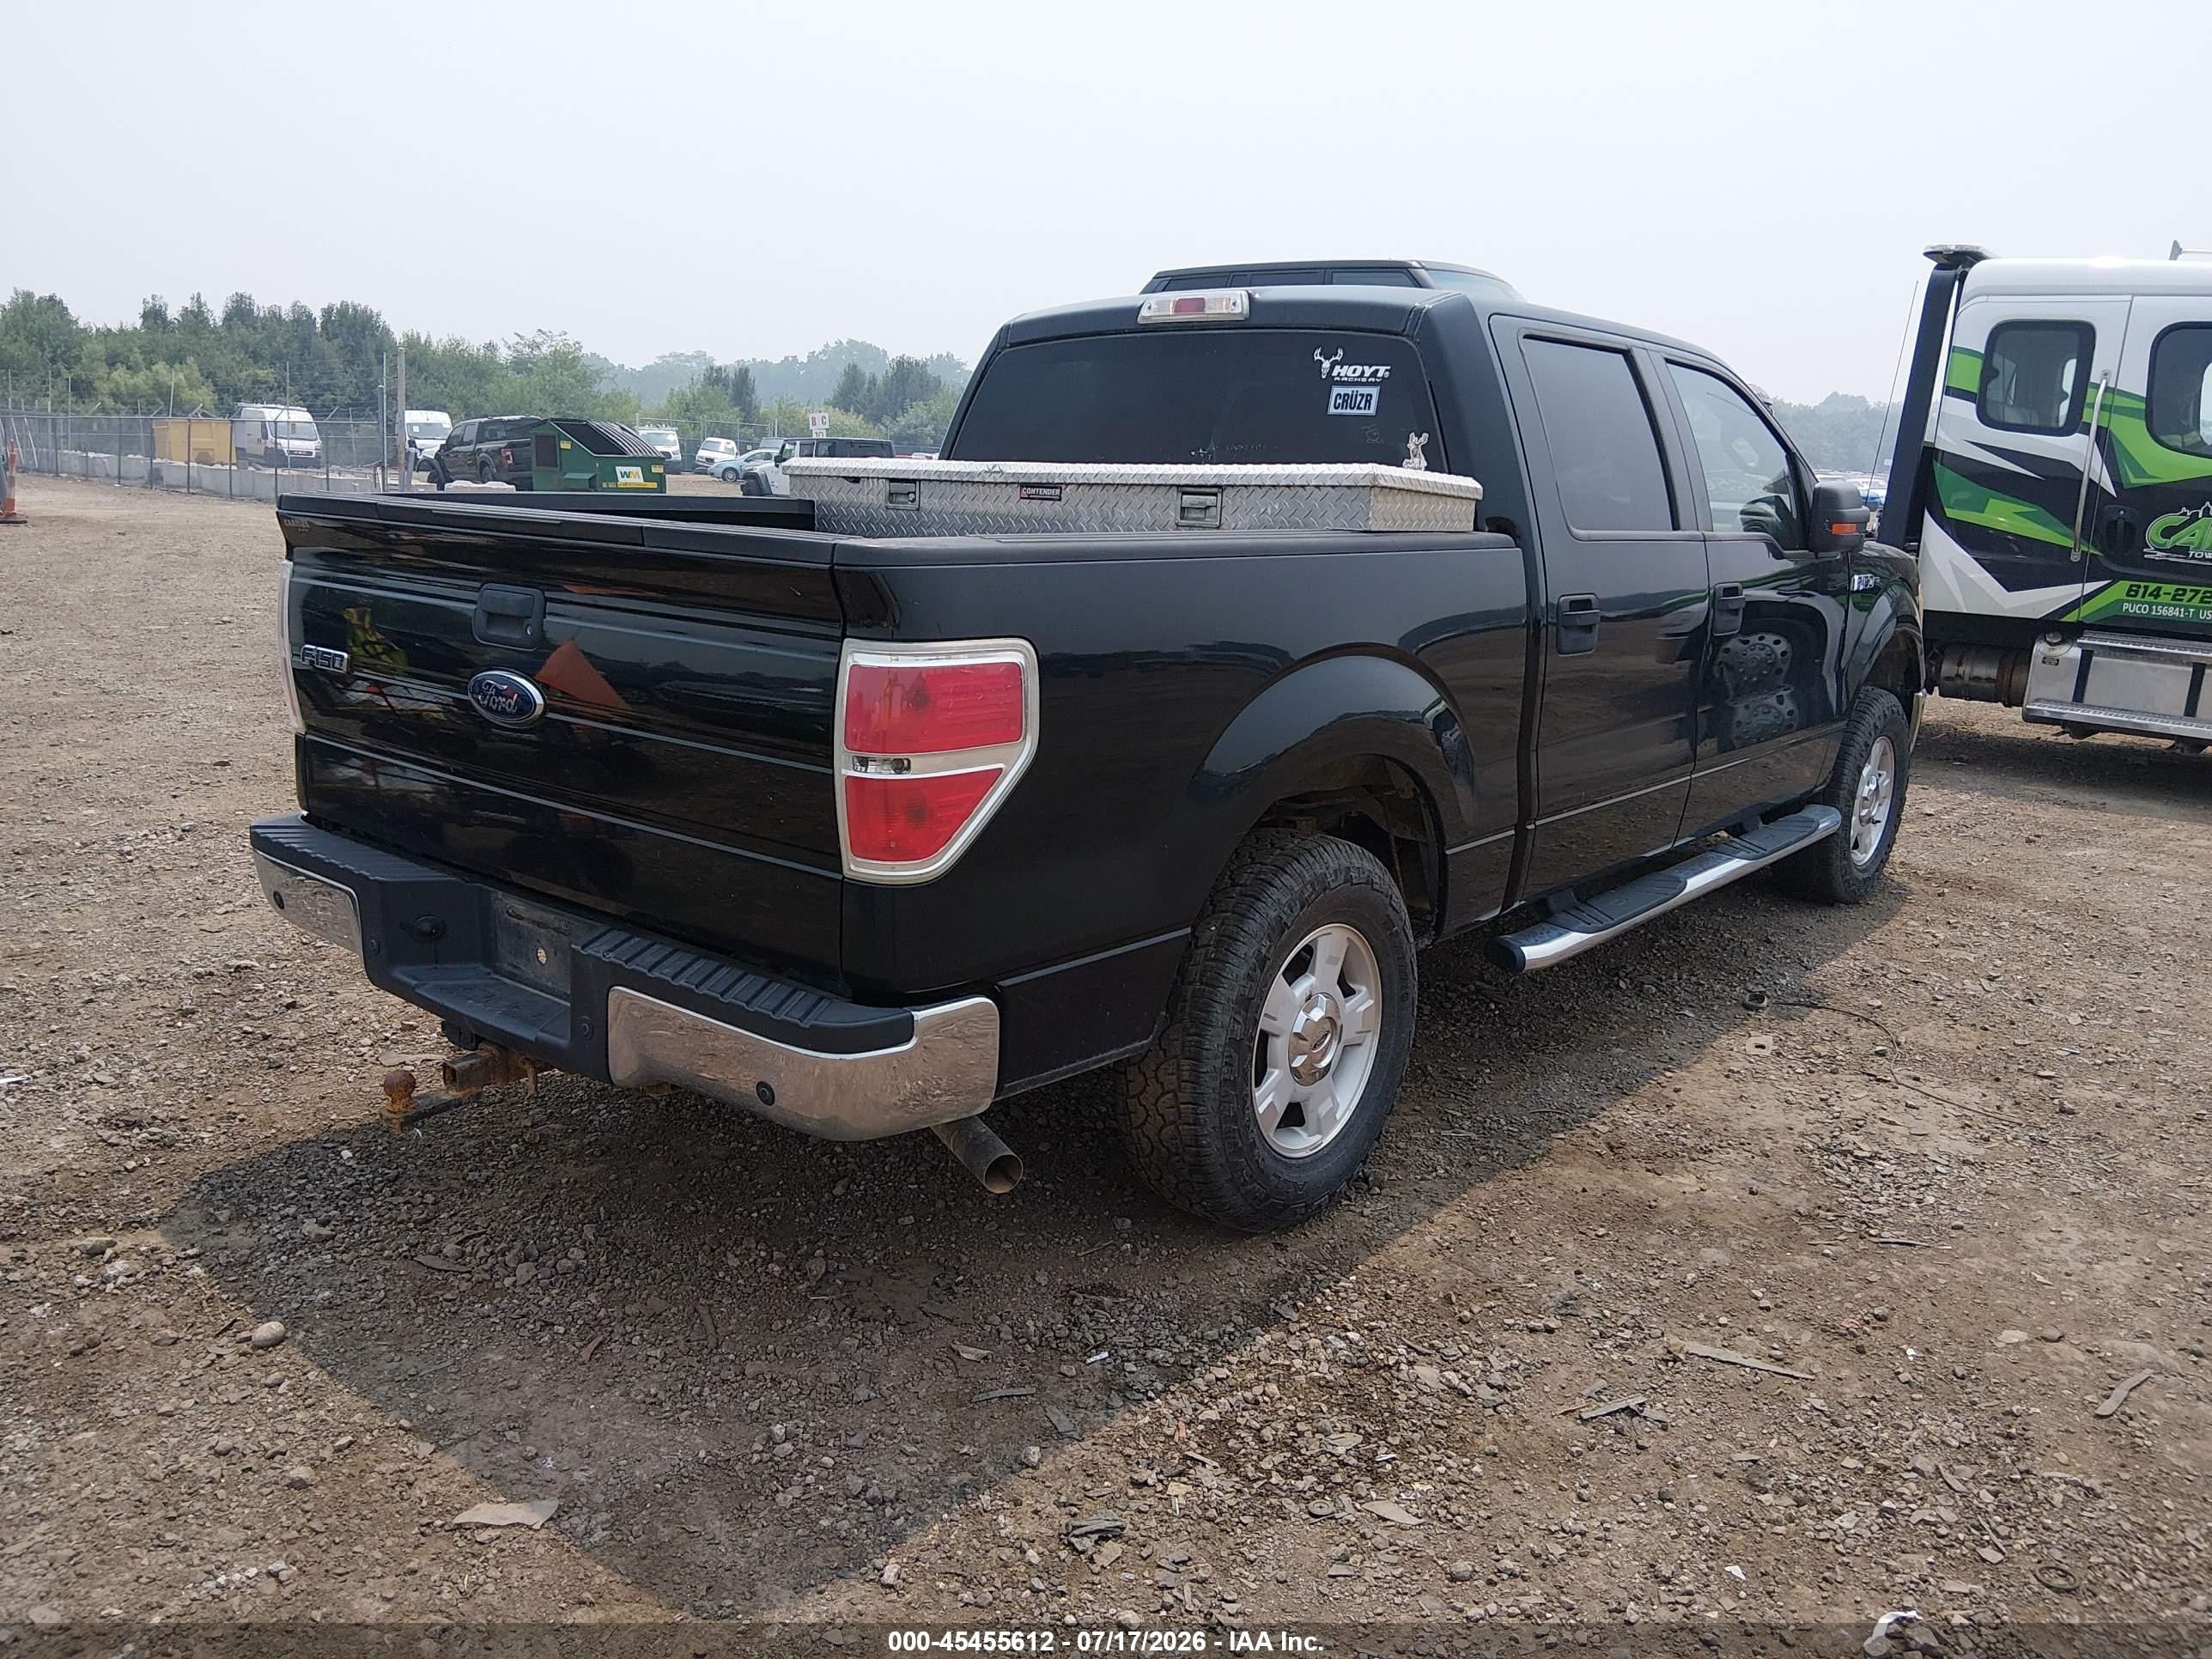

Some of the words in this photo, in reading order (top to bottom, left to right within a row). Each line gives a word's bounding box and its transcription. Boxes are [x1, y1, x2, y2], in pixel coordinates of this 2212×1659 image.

[1332, 365, 1390, 378] HOYT
[1333, 390, 1373, 410] CRÜZR
[619, 471, 641, 479] WM
[1022, 487, 1060, 495] CONTENDER
[2122, 603, 2149, 614] PUCO
[2151, 605, 2195, 618] 156841-T
[478, 679, 520, 714] Ford
